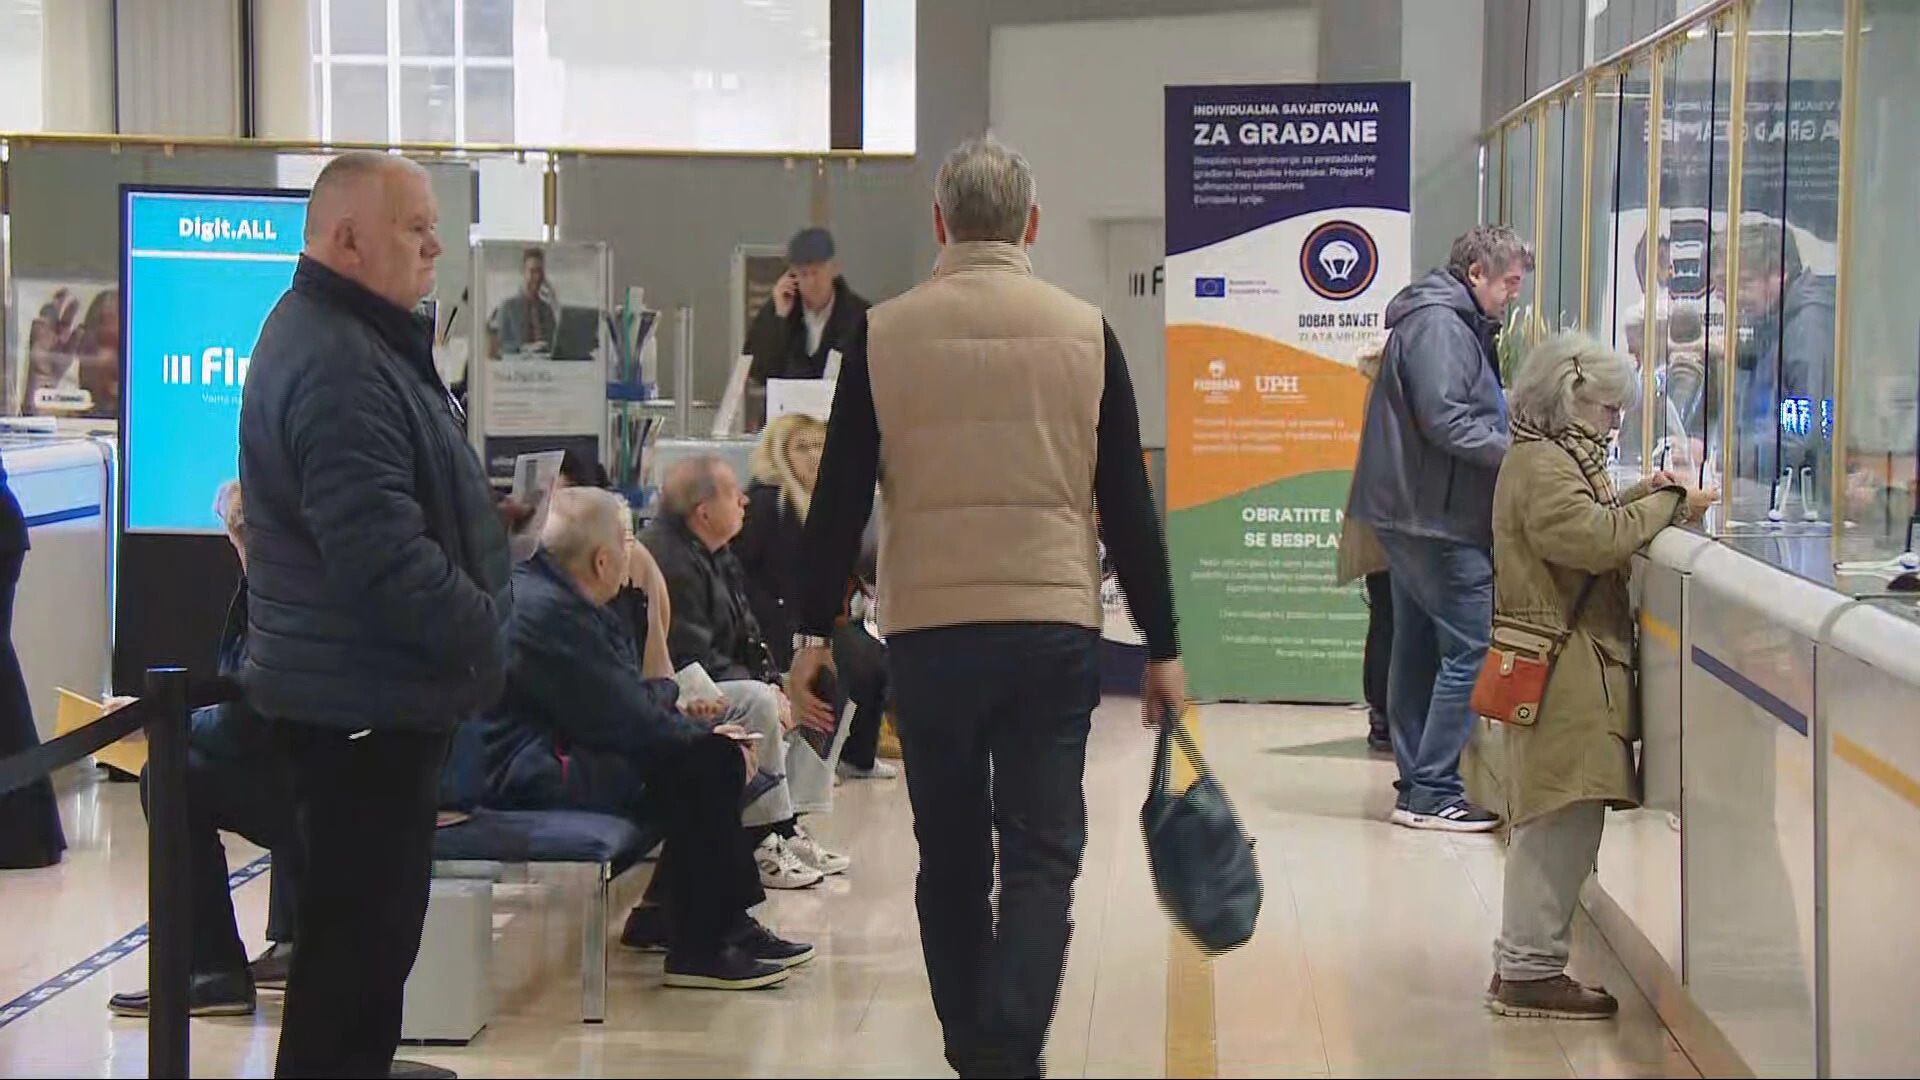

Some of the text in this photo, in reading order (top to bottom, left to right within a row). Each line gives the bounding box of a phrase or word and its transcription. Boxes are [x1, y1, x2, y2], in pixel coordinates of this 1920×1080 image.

[1194, 102, 1379, 116] INDIVIDUALNA SAVJETOVANJA
[1194, 120, 1377, 146] ZA GRAĐANE
[179, 217, 278, 242] Digit.ALL
[1298, 312, 1378, 328] DOBAR SAVJET
[1255, 375, 1300, 393] UPH
[1242, 507, 1330, 523] OBRATITE
[1244, 533, 1343, 549] SE BESPLA
